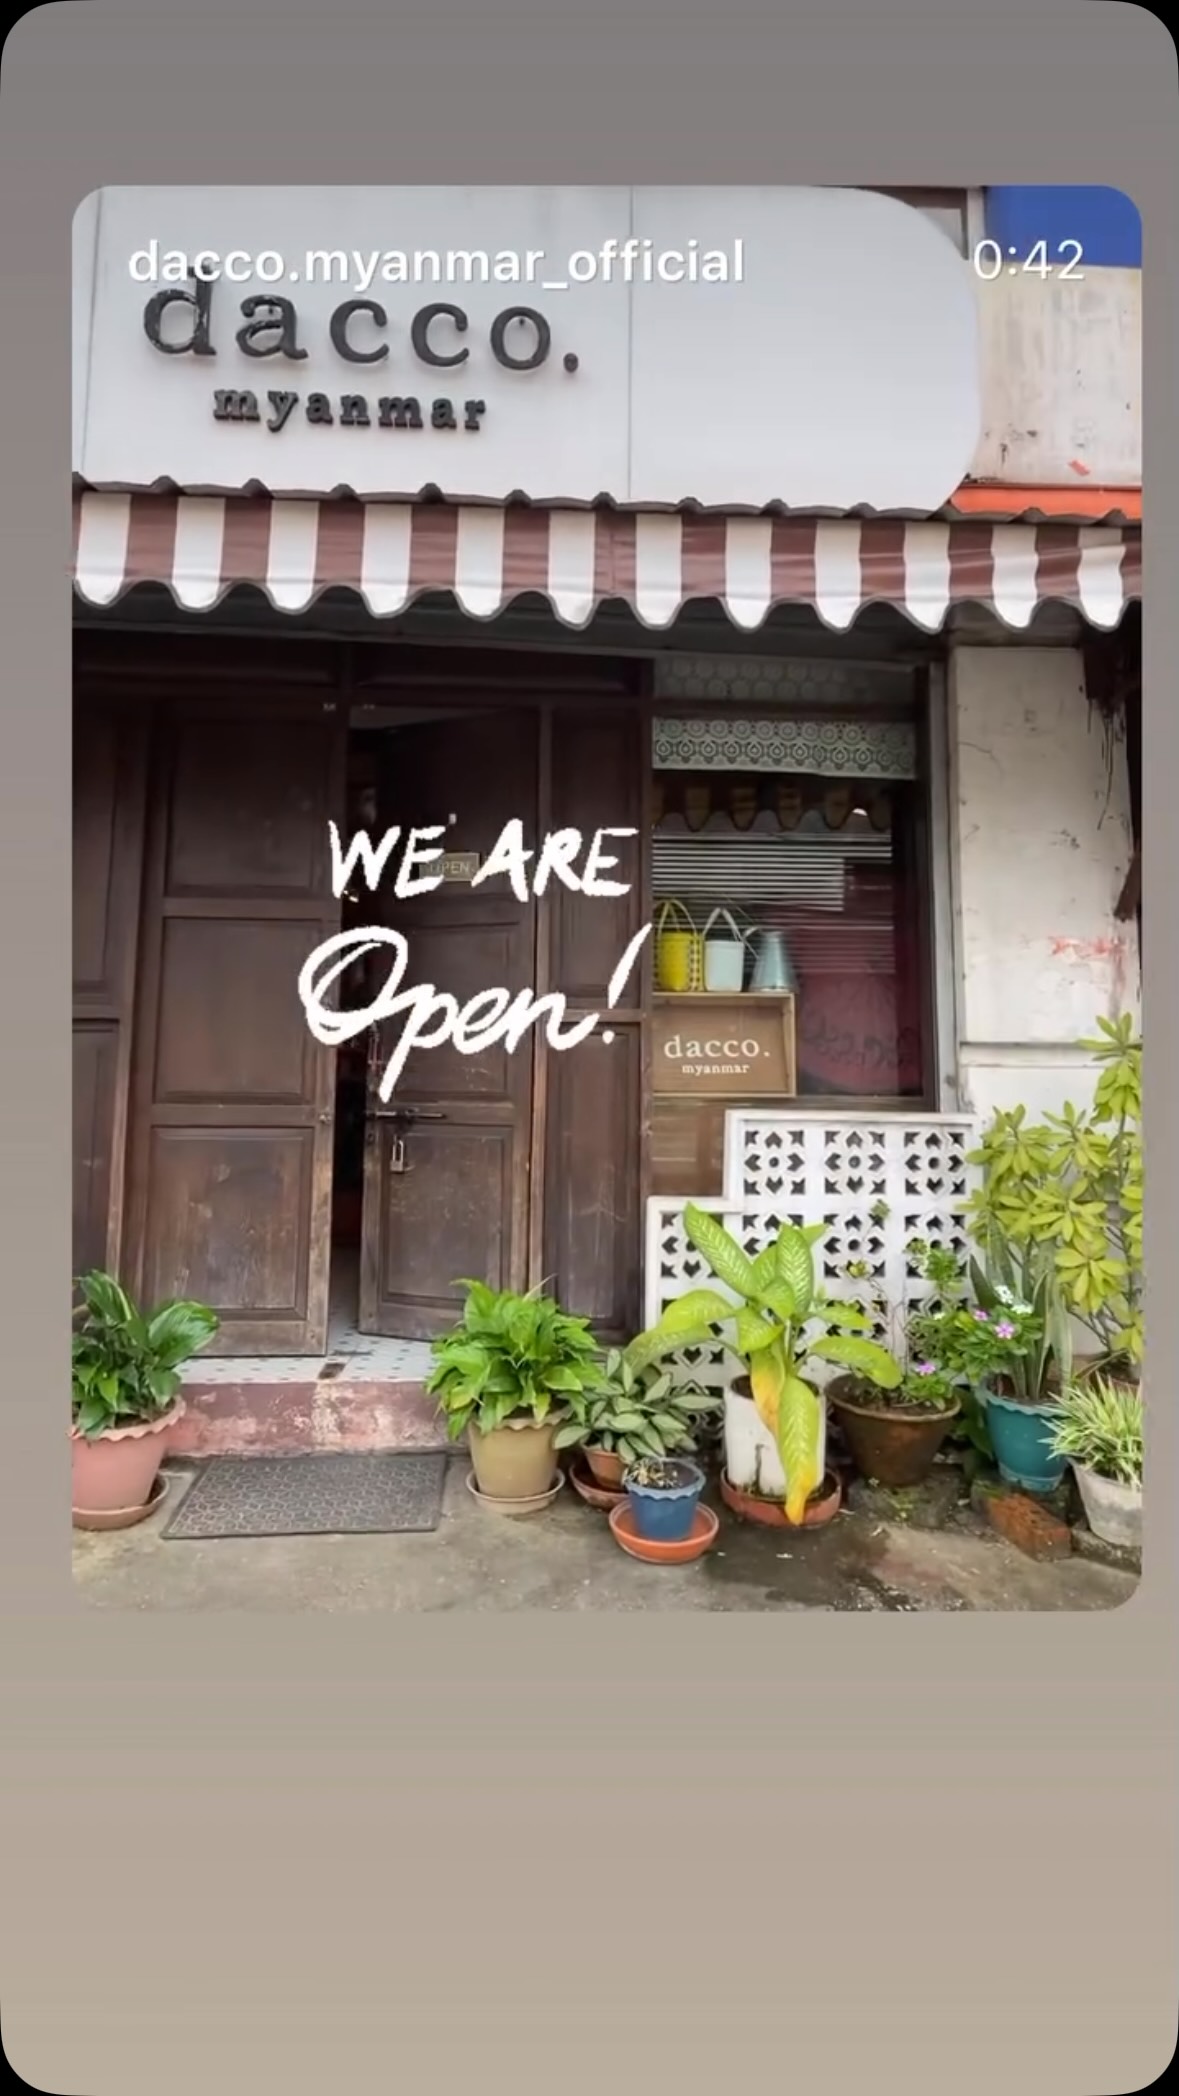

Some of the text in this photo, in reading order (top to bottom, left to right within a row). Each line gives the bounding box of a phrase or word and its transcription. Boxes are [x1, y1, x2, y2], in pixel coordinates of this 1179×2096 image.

[142, 264, 579, 372] dacco.
[213, 387, 486, 432] myanmar
[663, 1035, 770, 1058] dacco.
[681, 1062, 750, 1076] myanmar
